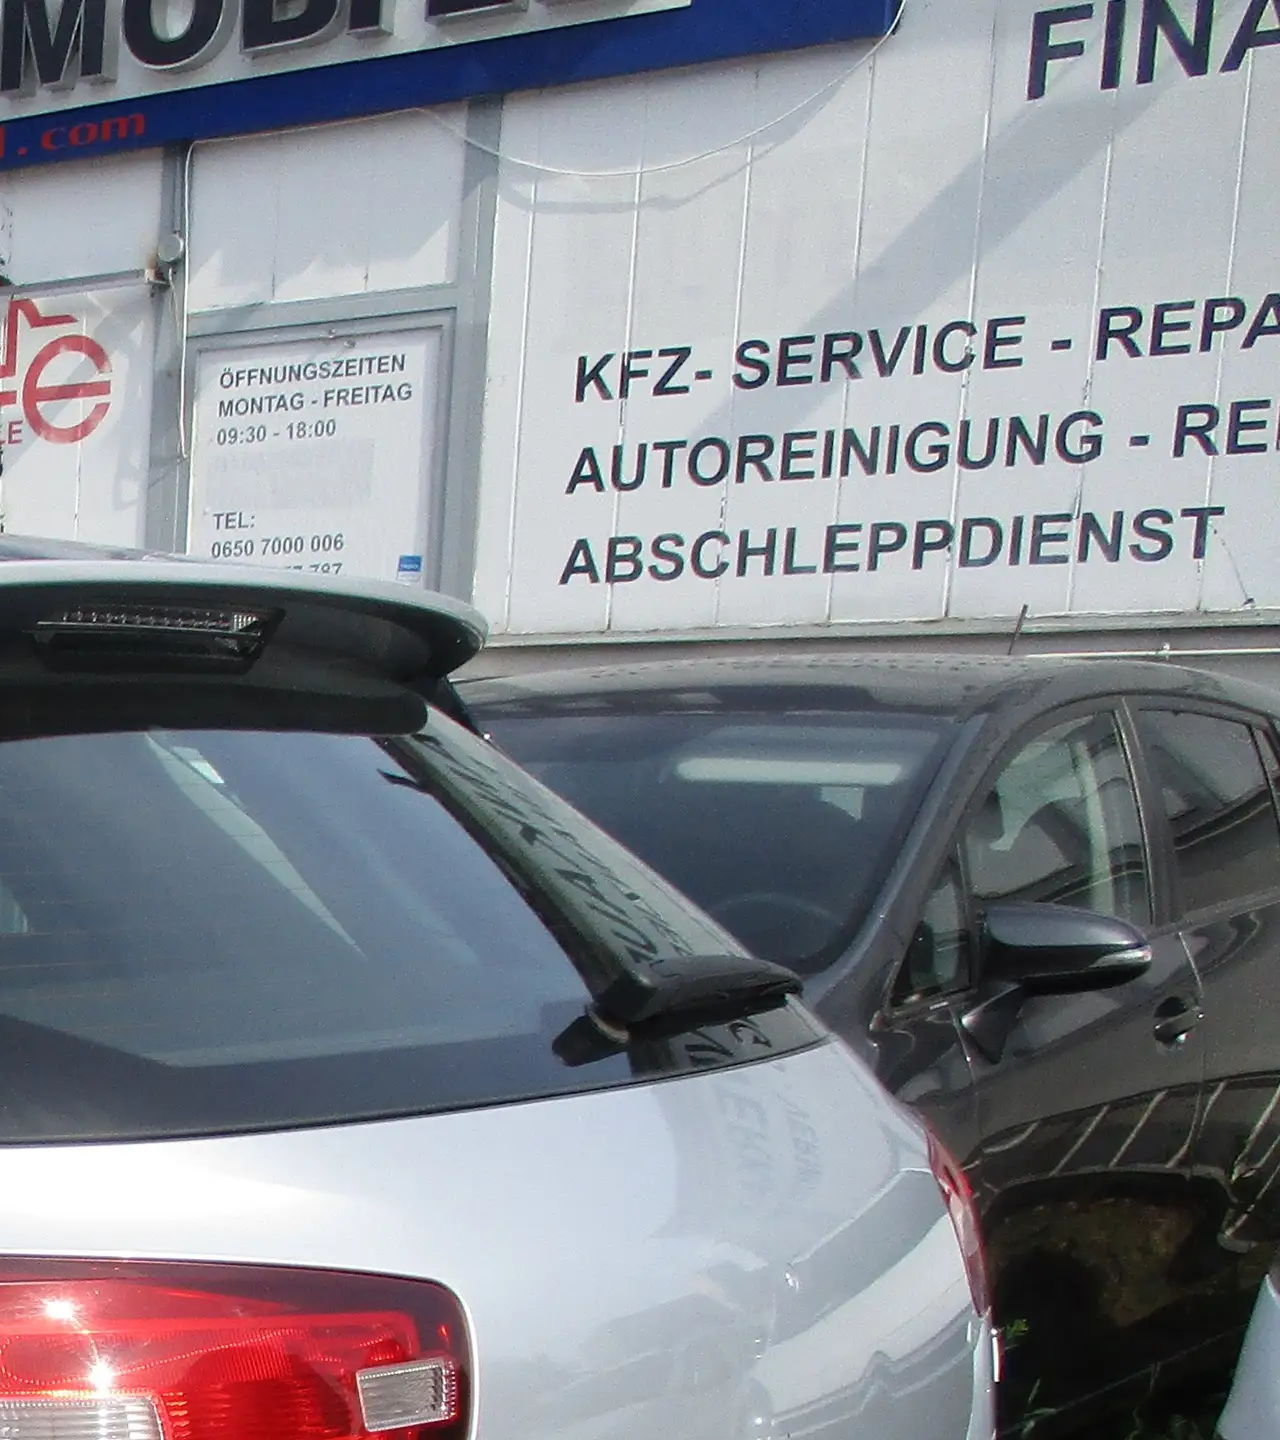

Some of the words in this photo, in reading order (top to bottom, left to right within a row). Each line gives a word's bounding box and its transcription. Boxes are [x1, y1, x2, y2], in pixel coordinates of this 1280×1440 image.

[731, 316, 1026, 390] SERVICE
[219, 354, 406, 389] ÖFFNUNGSZEITEN
[218, 392, 304, 418] MONTAG
[323, 383, 413, 408] FREITAG
[217, 425, 266, 446] 09:30
[286, 419, 336, 441] 18:00
[565, 410, 1103, 494] AUTOREINIGUNG
[1173, 399, 1280, 458] RE
[213, 512, 256, 530] TEL:
[211, 540, 254, 558] 0650
[261, 536, 304, 556] 7000
[310, 533, 344, 552] 006
[558, 505, 1225, 585] ABSCHLEPPDIENST
